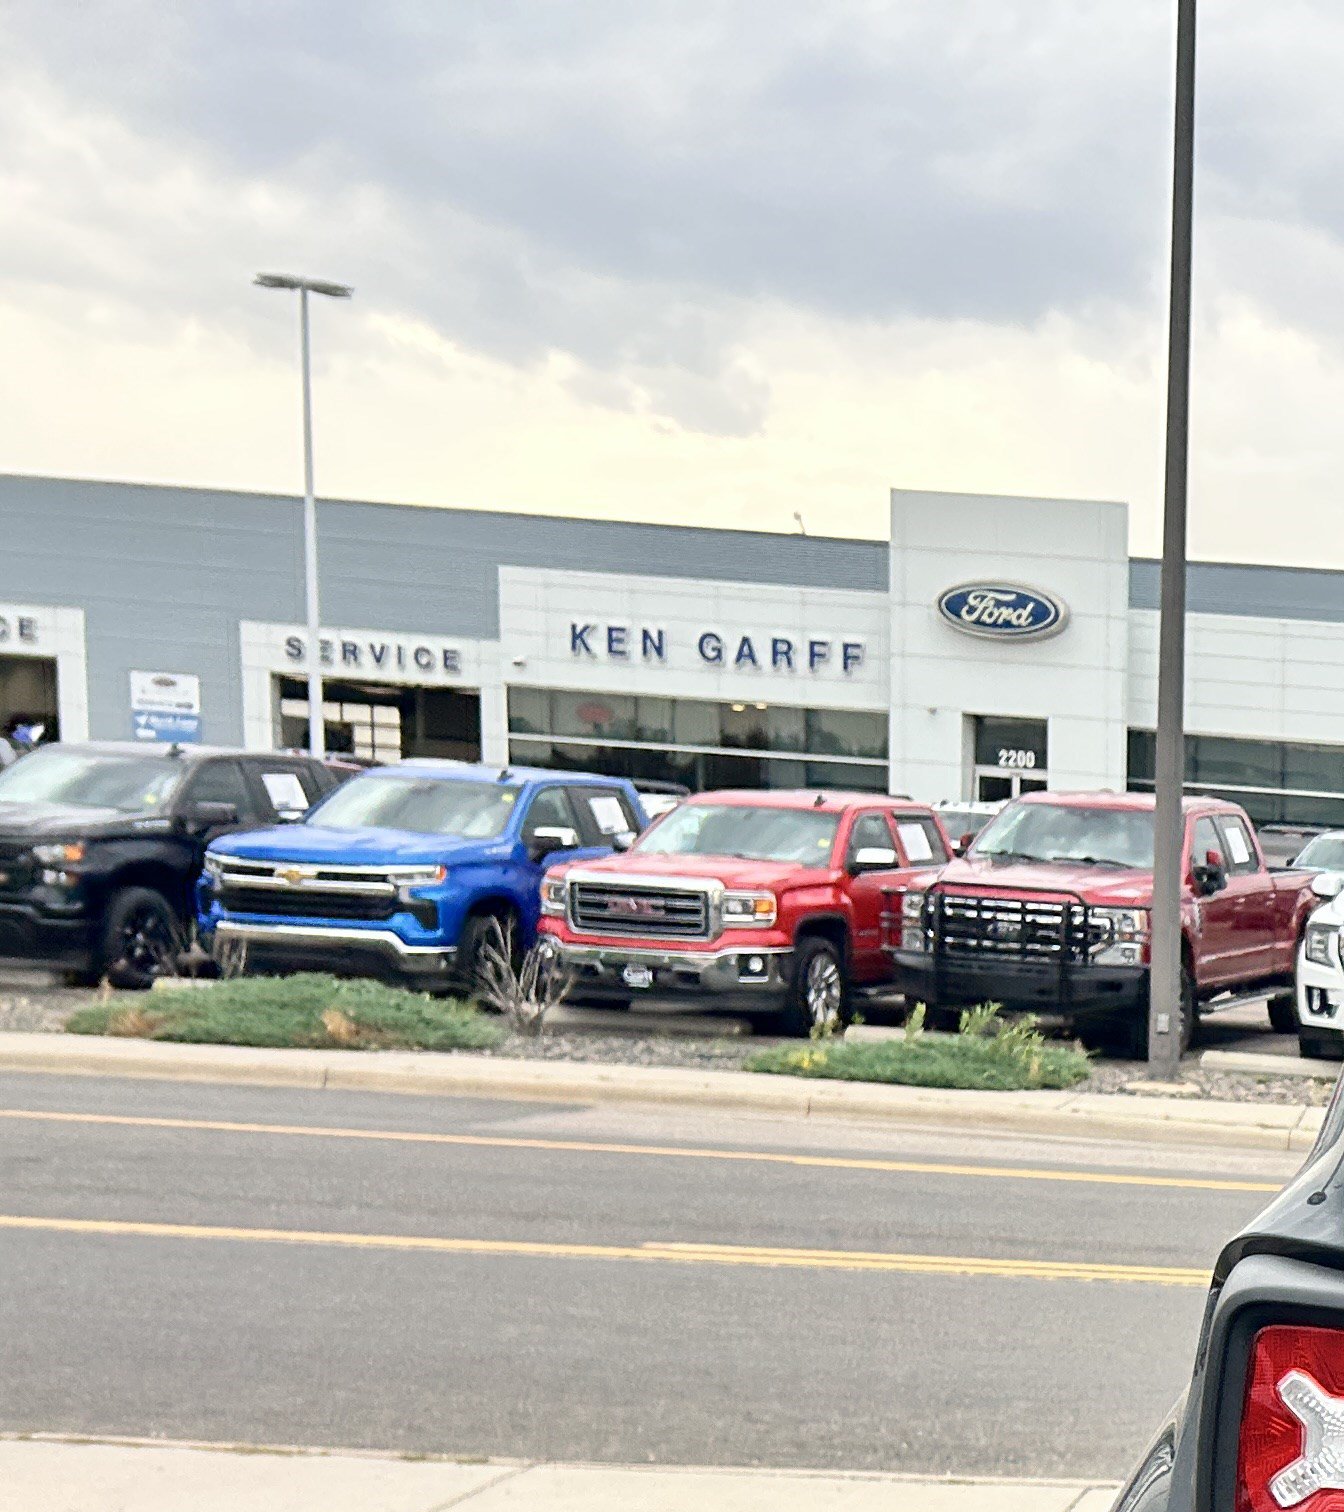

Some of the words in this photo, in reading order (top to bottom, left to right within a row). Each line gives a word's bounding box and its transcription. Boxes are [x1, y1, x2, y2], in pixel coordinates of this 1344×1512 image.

[961, 590, 1035, 627] Ford
[285, 637, 461, 674] SERVICE
[570, 623, 665, 659] KEN
[698, 632, 862, 673] GARFF
[998, 749, 1036, 768] 2200
